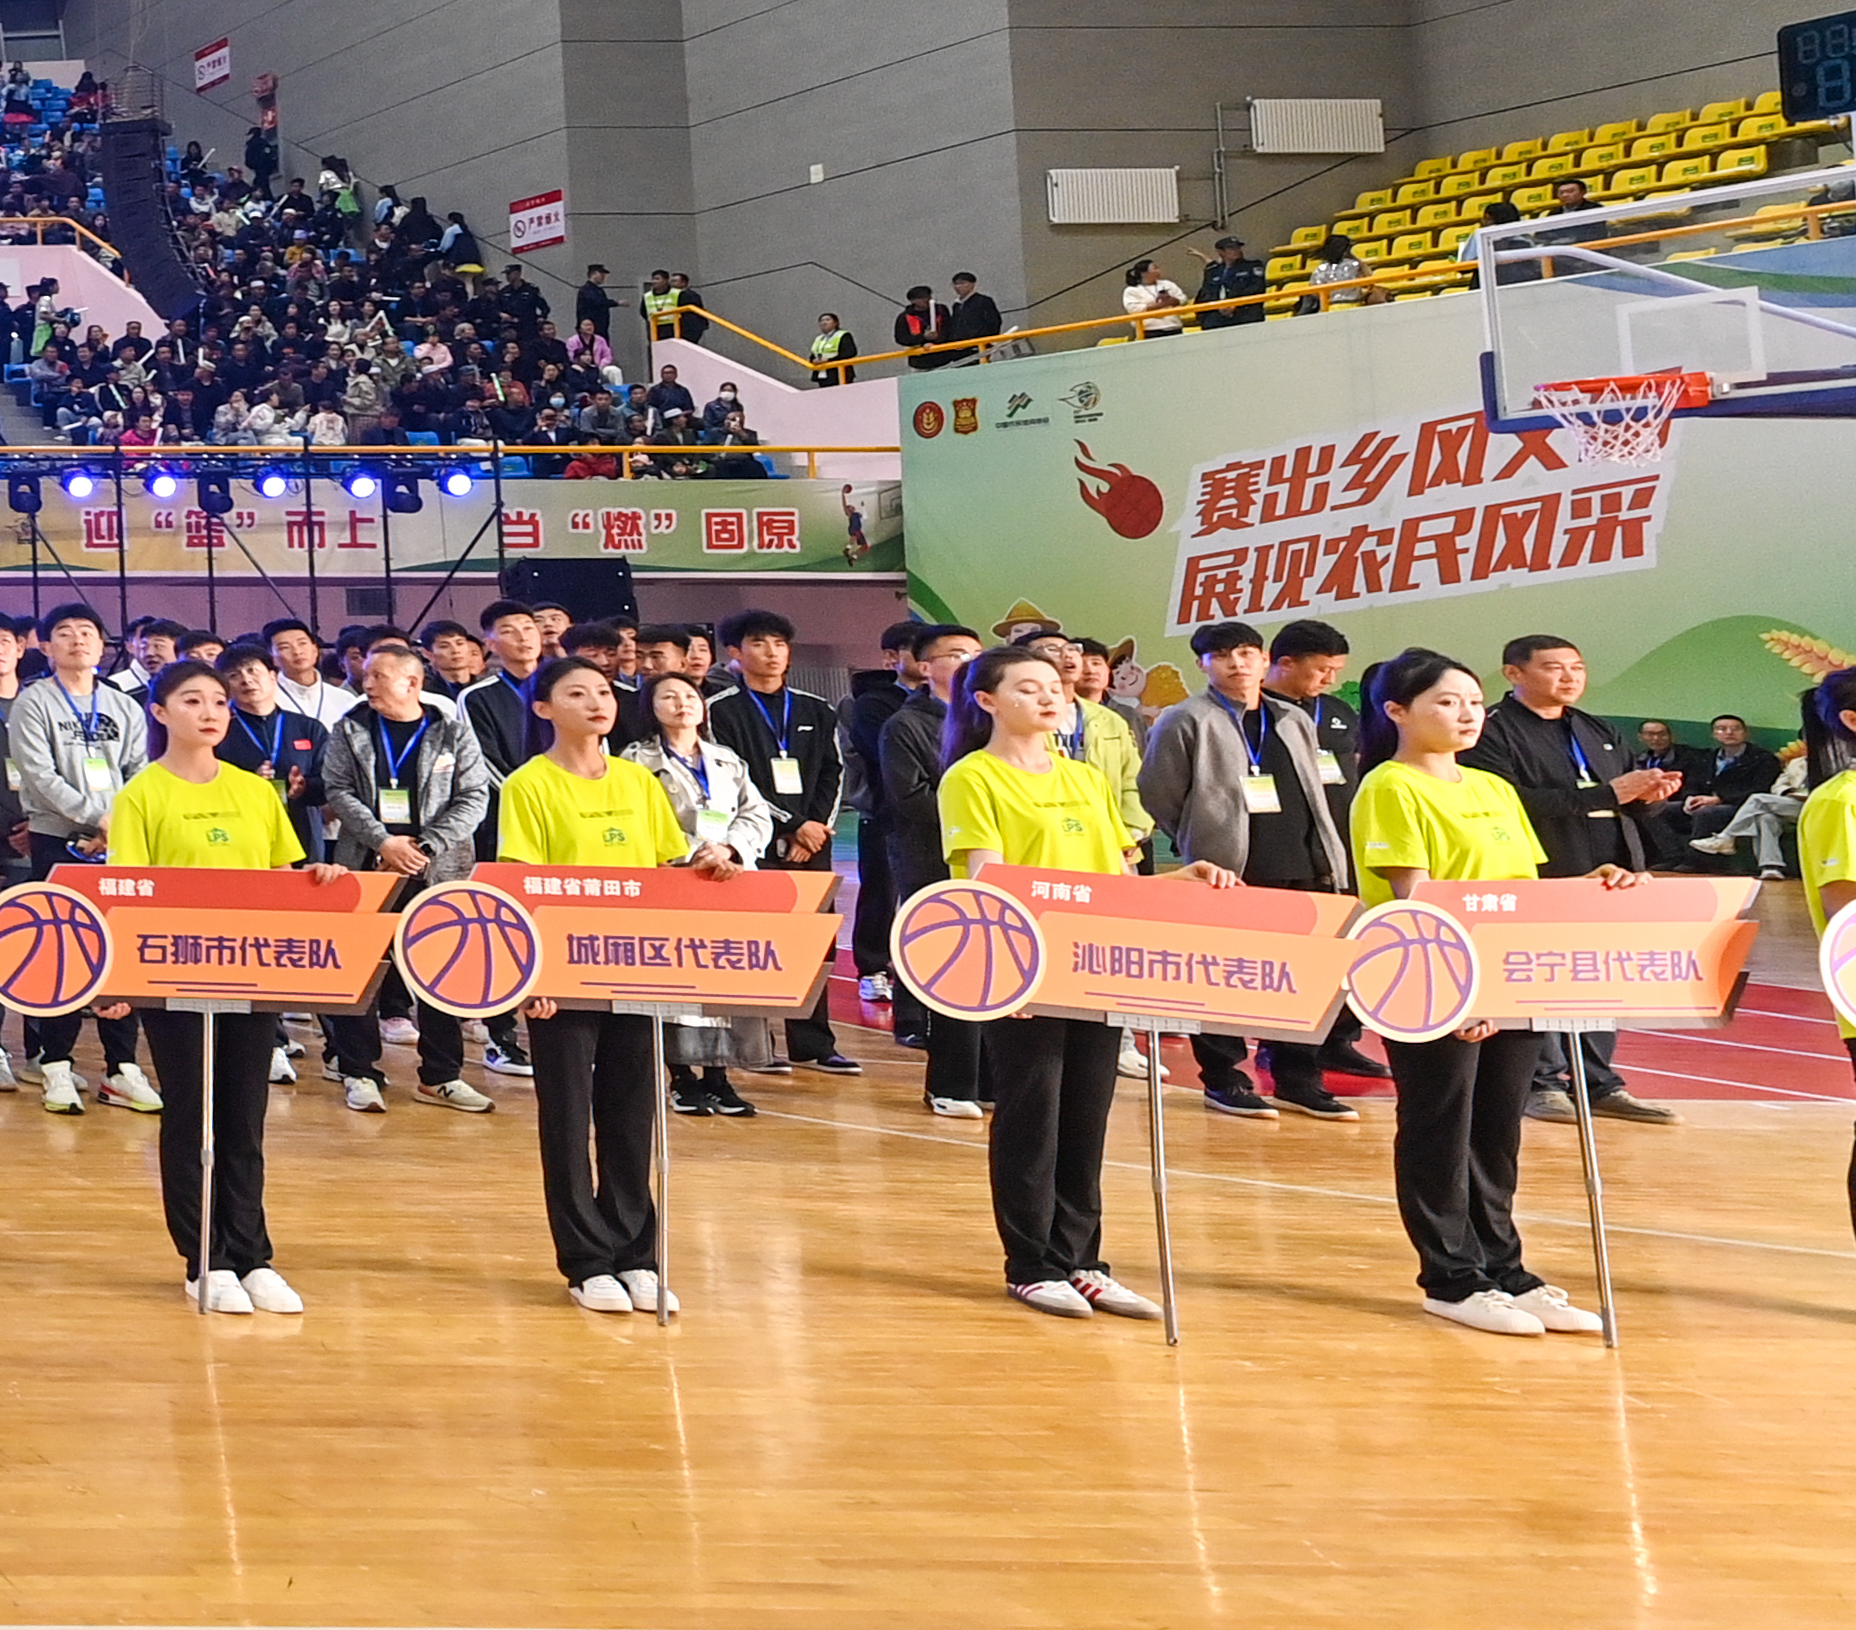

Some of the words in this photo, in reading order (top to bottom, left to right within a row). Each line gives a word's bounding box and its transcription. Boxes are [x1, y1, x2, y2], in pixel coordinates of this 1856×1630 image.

[1176, 473, 1661, 627] 展现农民风采
[98, 877, 155, 899] 福建省
[522, 874, 642, 900] 福建省莆田市
[1030, 879, 1093, 905] 河南省
[1461, 892, 1518, 914] 甘肃省
[135, 932, 341, 970] 石狮市代表队
[565, 932, 784, 973] 城厢区代表队
[1502, 949, 1704, 983] 会宁县代表队
[1070, 941, 1297, 996] 沁阳市代表队
